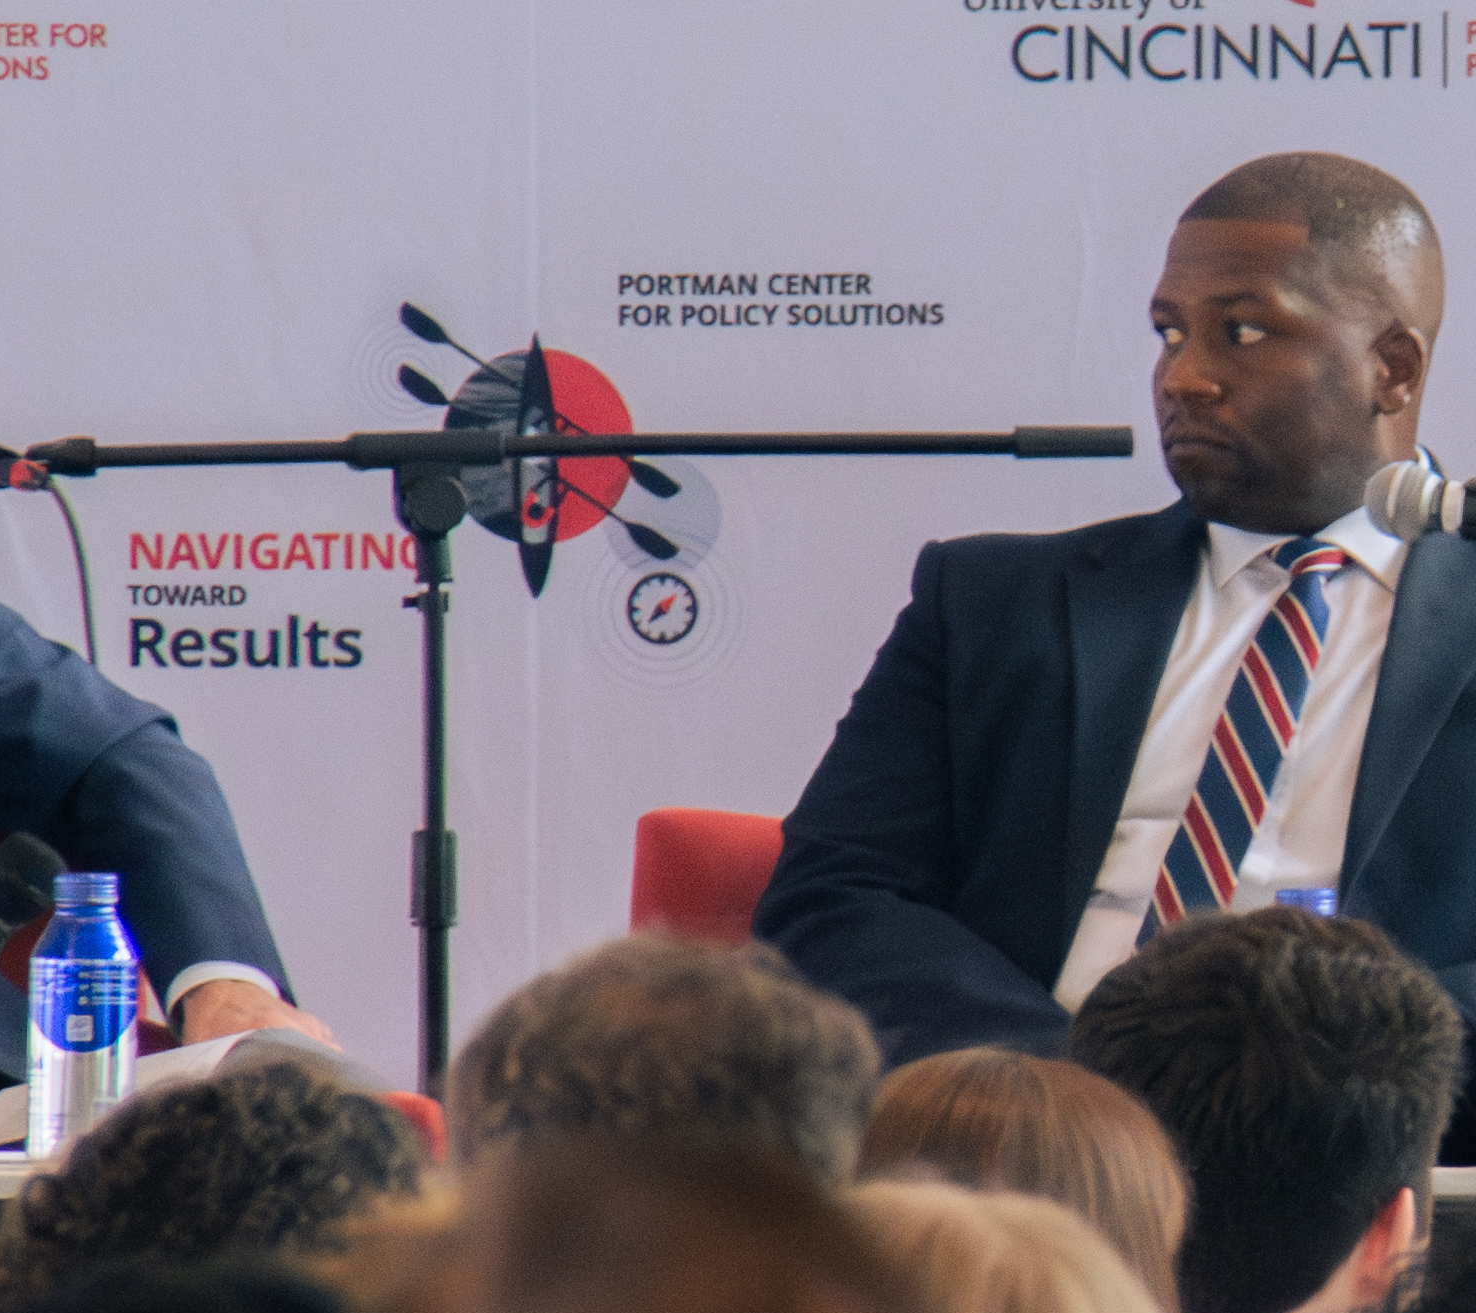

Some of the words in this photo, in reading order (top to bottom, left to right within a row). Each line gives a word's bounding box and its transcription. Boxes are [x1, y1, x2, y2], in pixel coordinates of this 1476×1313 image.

[49, 23, 107, 49] FOR
[1010, 23, 1422, 83] CINCINNATI
[618, 272, 758, 297] PORTMAN
[767, 272, 872, 297] CENTER
[618, 303, 671, 327] FOR
[680, 303, 779, 327] POLICY
[787, 302, 945, 327] SOLUTIONS
[127, 583, 248, 607] TOWARD
[128, 614, 364, 669] Results
